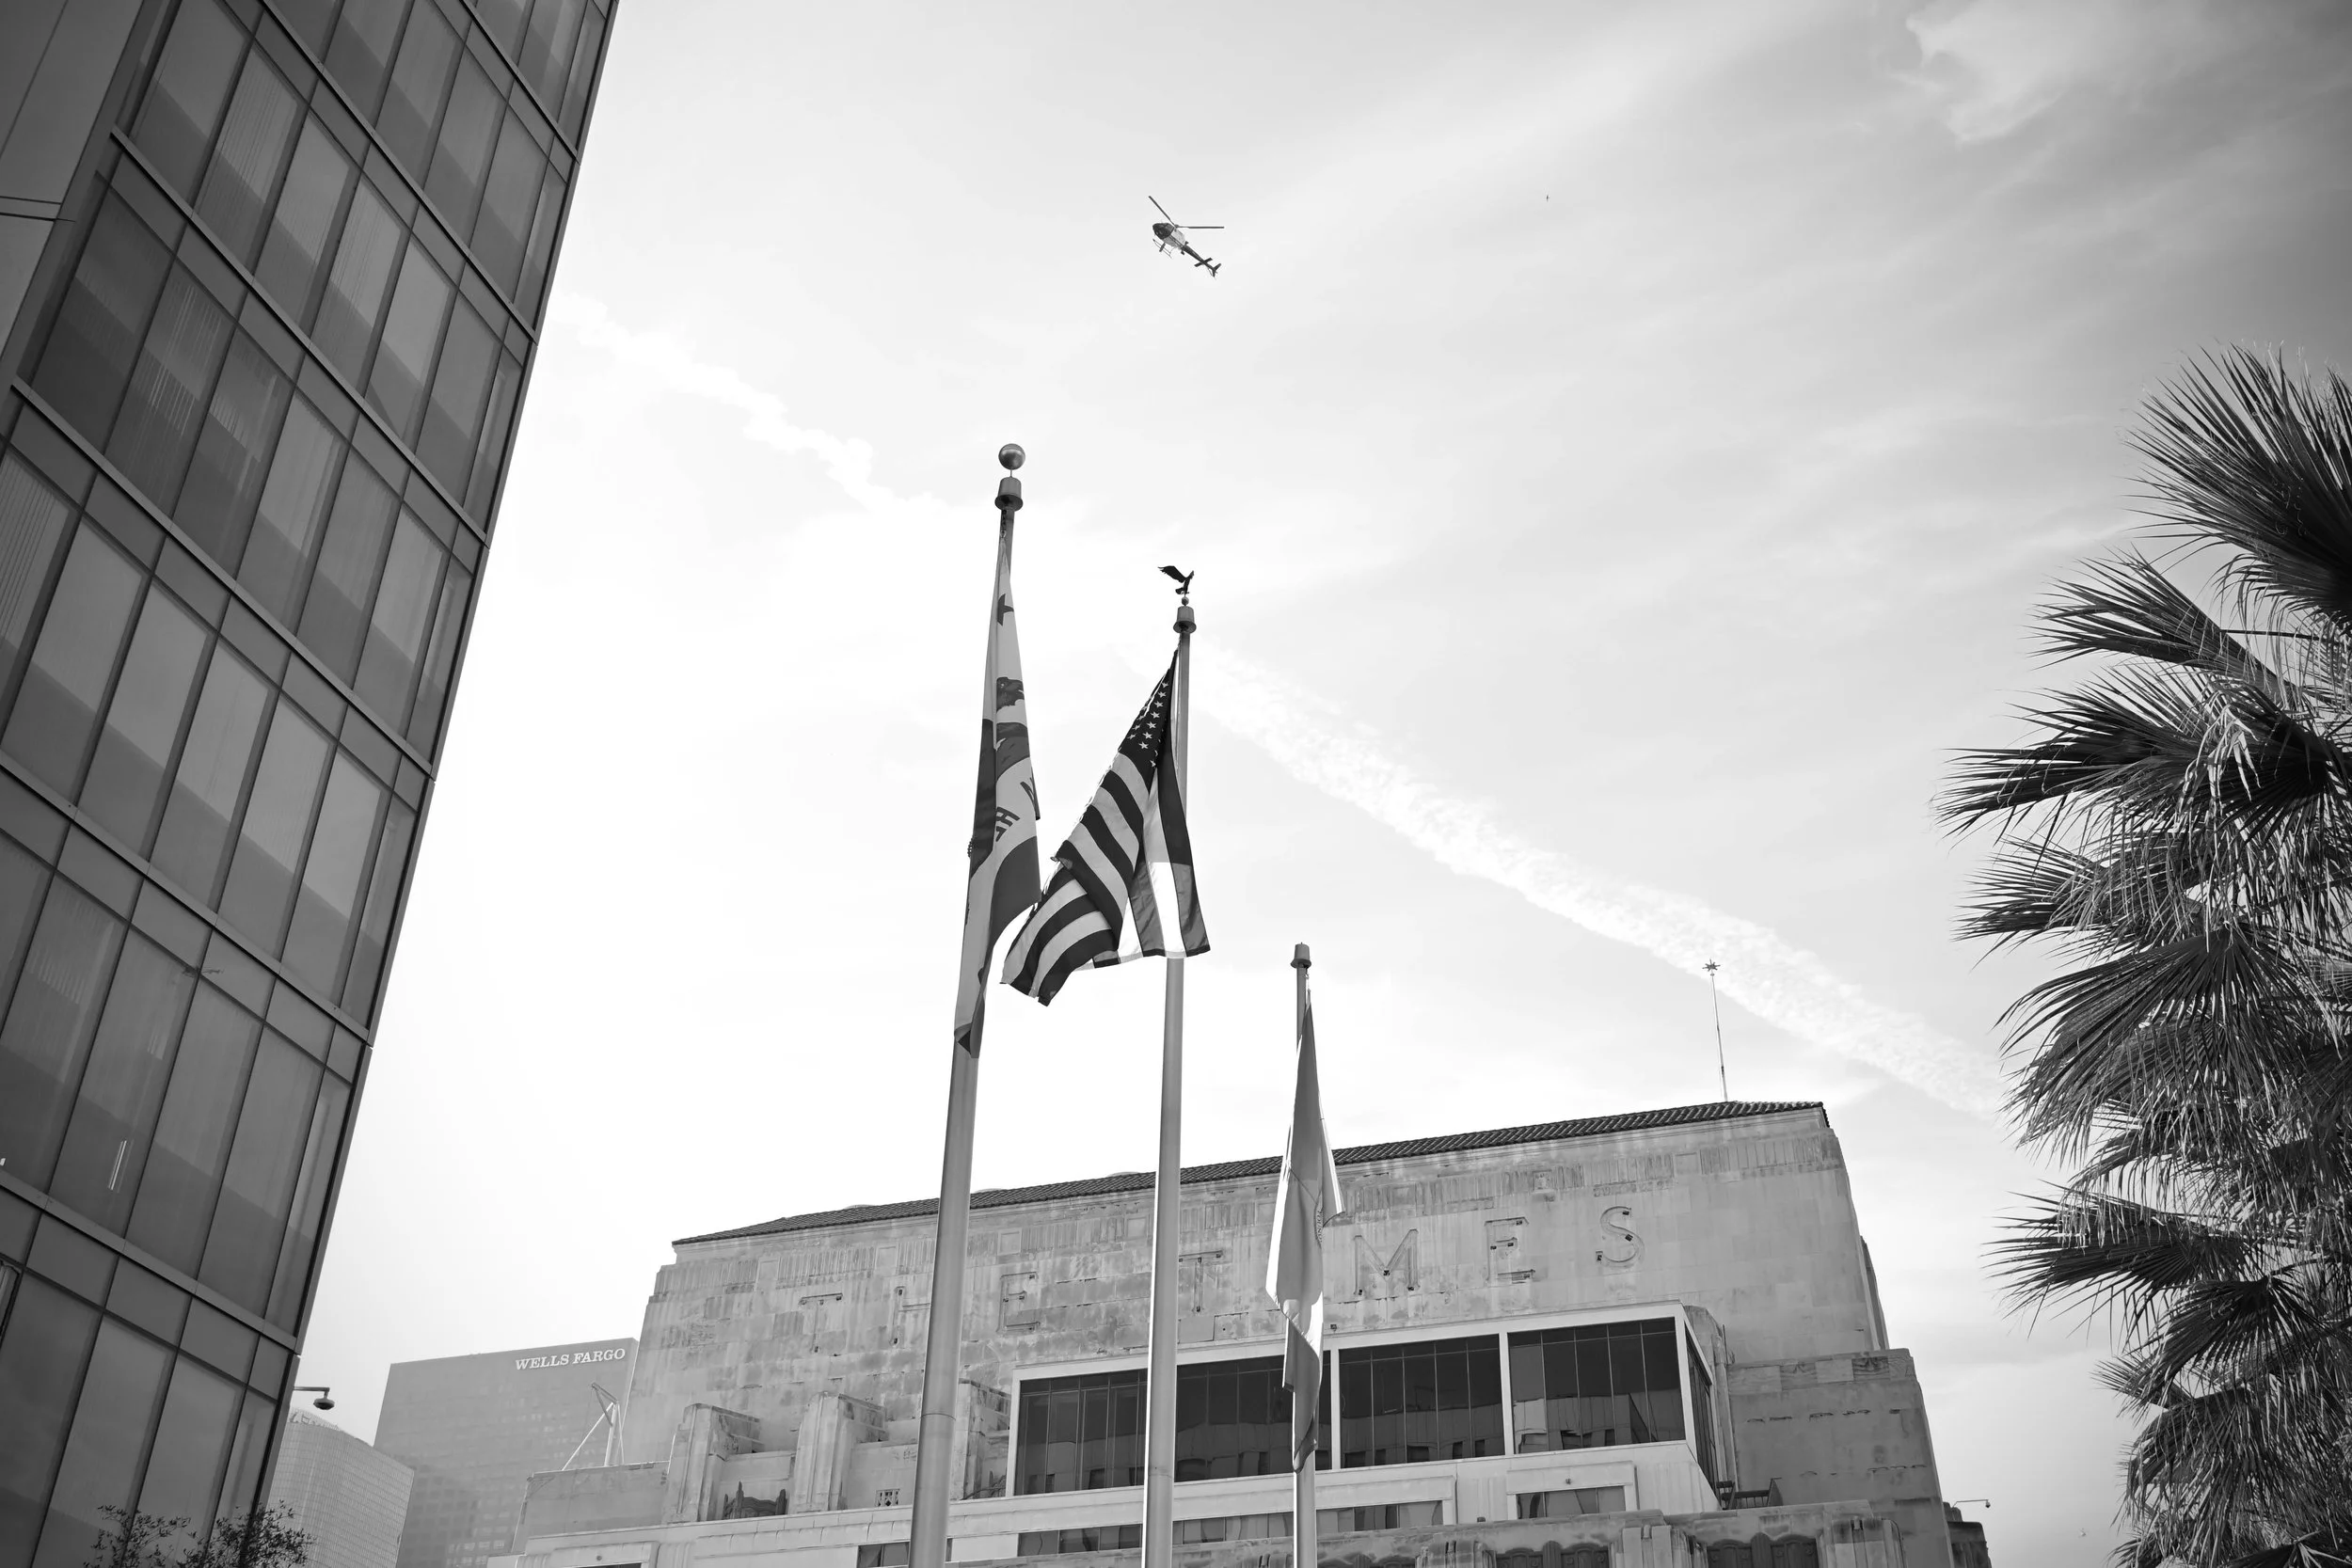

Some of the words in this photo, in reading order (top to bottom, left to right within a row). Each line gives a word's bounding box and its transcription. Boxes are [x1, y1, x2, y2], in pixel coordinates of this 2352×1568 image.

[1178, 1205, 1646, 1313] TMES
[516, 1354, 570, 1370] WELLS
[572, 1348, 627, 1365] FARGO
